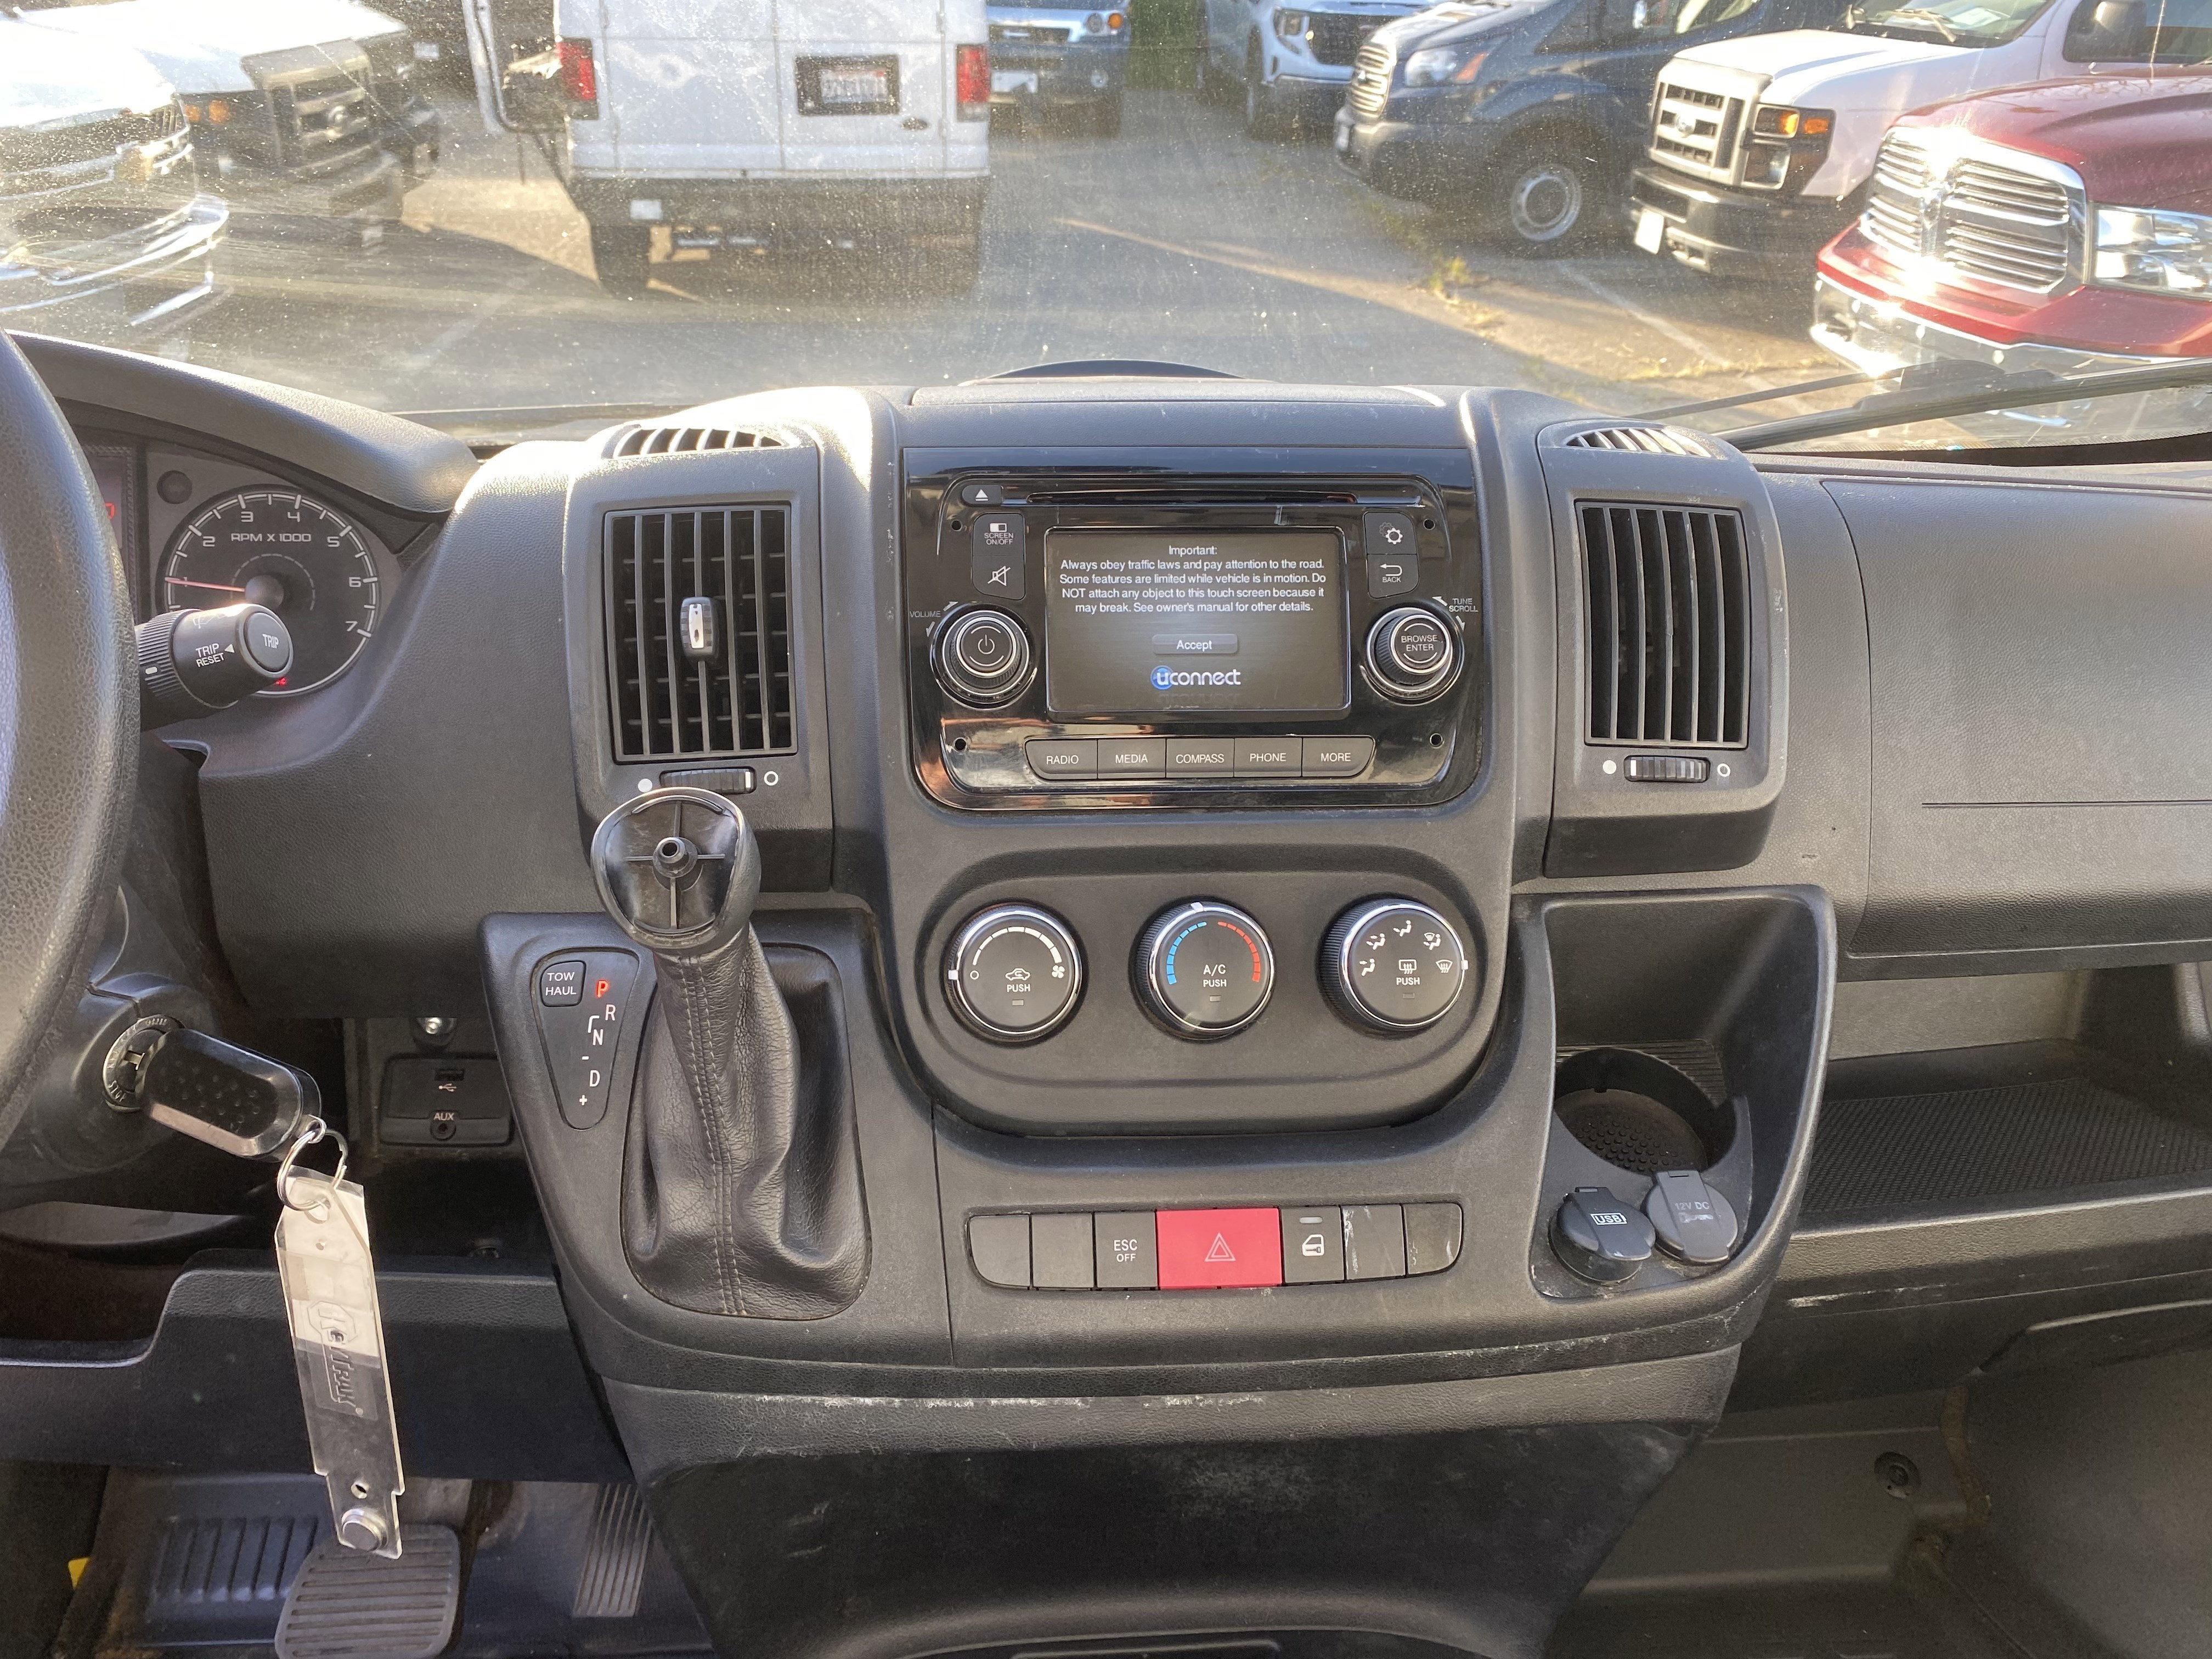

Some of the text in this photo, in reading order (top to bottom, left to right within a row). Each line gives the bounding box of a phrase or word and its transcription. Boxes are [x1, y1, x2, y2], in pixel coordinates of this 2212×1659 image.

[240, 511, 254, 522] 3
[287, 511, 301, 523] 4
[202, 536, 216, 547] 2
[230, 533, 312, 542] RPM X 1000
[327, 536, 340, 548] 5
[1169, 545, 1217, 557] Important:
[1060, 558, 1324, 572] Always obey traffic laws and pay attention to the road.
[348, 577, 362, 588] 6
[1059, 573, 1327, 584] Some features are limited while vehicle is in motion. Do
[1062, 586, 1324, 600] NOT attach any object to this touch screen because it
[1075, 601, 1314, 615] may break. See owner's manual for other details.
[345, 620, 358, 632] 7
[262, 633, 279, 649] TRIP
[1401, 634, 1438, 643] BROWSE
[195, 643, 219, 657] TRIP
[1176, 639, 1212, 652] Accept
[1406, 644, 1434, 652] ENTER
[196, 653, 224, 667] RESET
[1156, 669, 1241, 686] uconnect
[1046, 754, 1079, 765] RADIO
[1115, 754, 1148, 764] MEDIA
[1176, 753, 1224, 764] COMPASS
[1250, 753, 1286, 762] PHONE
[1321, 752, 1351, 762] MORE
[1203, 964, 1226, 977] A/C
[547, 972, 575, 981] TOW
[1396, 977, 1420, 986] PUSH
[596, 980, 609, 997] P
[1007, 984, 1031, 992] PUSH
[1203, 979, 1227, 988] PUSH
[545, 986, 577, 996] HAUL
[605, 1004, 616, 1021] R
[592, 1029, 603, 1046] N
[589, 1070, 600, 1087] D
[433, 1112, 454, 1121] AUX
[1595, 1215, 1622, 1223] USB
[1114, 1239, 1138, 1251] ESC
[1116, 1253, 1136, 1262] OFF
